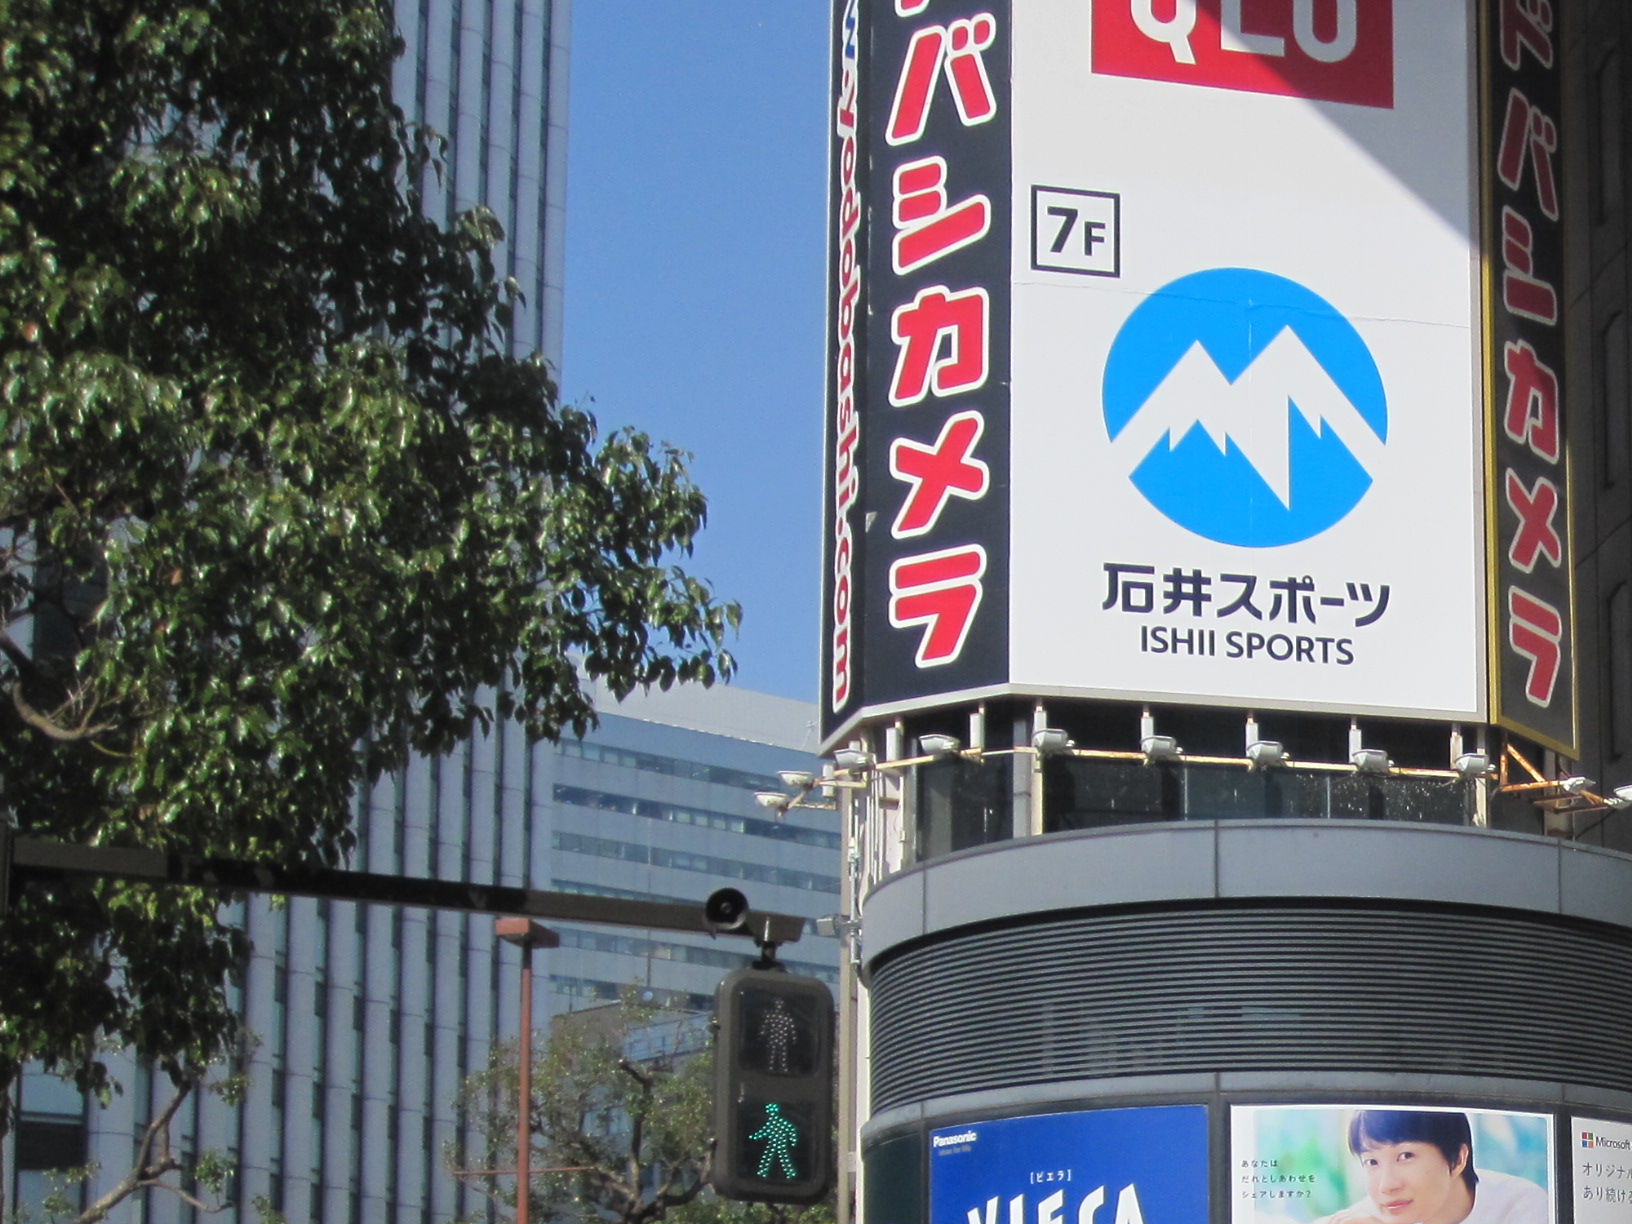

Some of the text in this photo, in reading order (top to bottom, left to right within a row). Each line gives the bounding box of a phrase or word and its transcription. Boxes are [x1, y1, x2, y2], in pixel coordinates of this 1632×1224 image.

[885, 0, 996, 668] バシカメラ
[1102, 562, 1390, 628] 石井スポーツ
[1140, 626, 1355, 666] ISHII SPORTS
[932, 1130, 977, 1148] Panasonic
[1595, 1136, 1630, 1151] Microsoft
[1241, 1159, 1278, 1168] あなたは
[1241, 1174, 1316, 1183] だれとしあわせを
